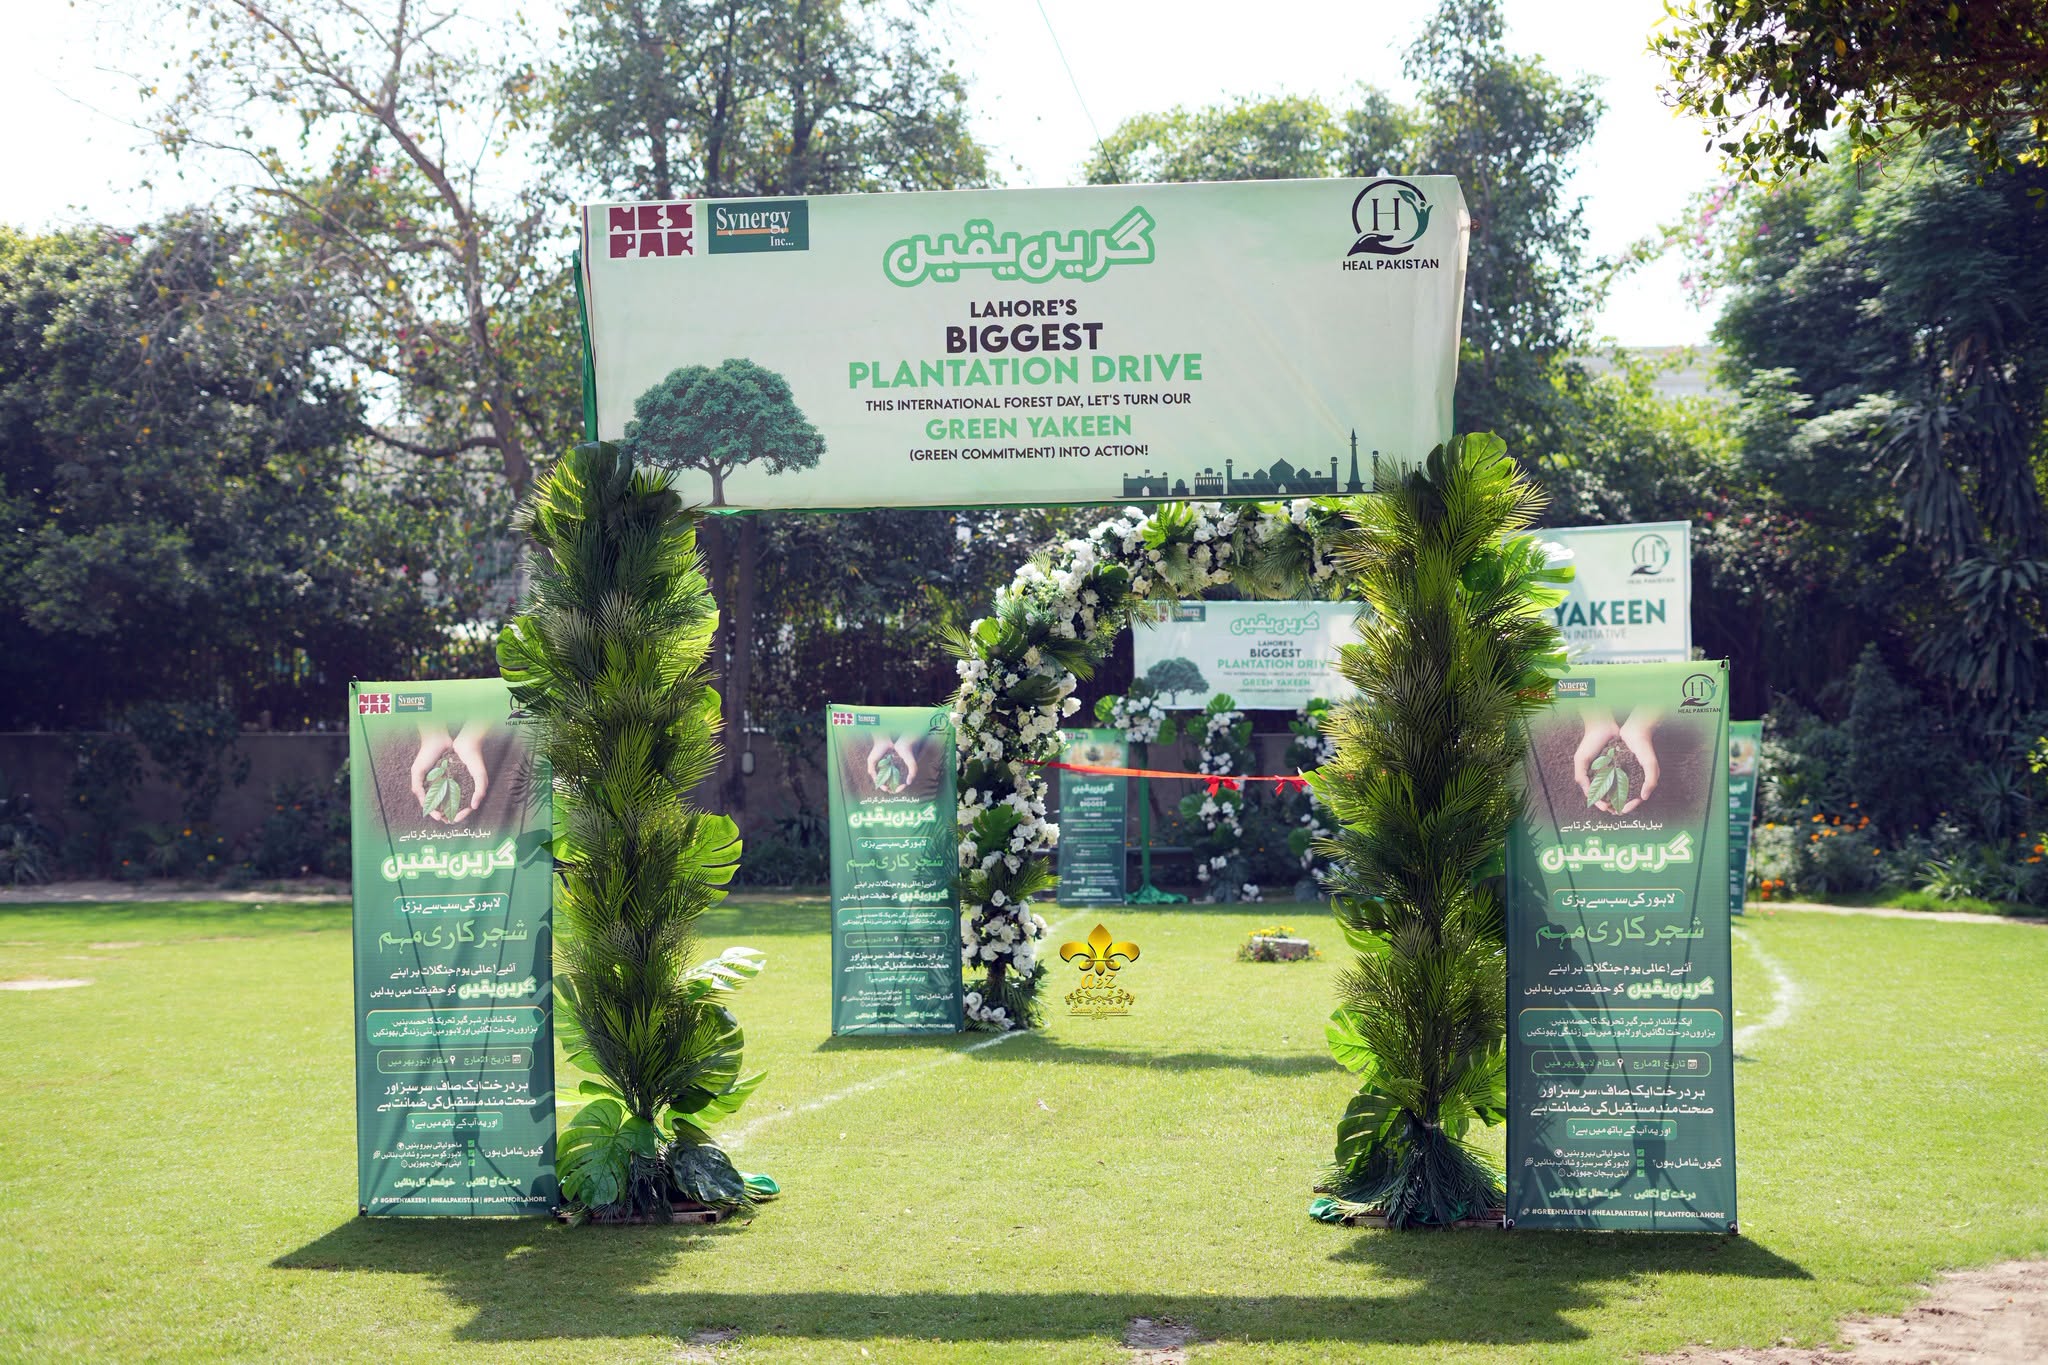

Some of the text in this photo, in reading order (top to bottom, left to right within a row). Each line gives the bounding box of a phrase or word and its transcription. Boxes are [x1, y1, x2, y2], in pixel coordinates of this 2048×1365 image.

[716, 207, 791, 235] Synergy
[770, 236, 794, 246] Inc...
[884, 206, 1155, 287] گرین یقین
[1343, 259, 1439, 270] HEAL PAKISTAN
[970, 299, 1077, 318] LAHORE'S
[946, 322, 1103, 353] BIGGEST
[849, 353, 1202, 388] PLANTATION DRIVE
[865, 392, 1191, 411] THIS INTERNATIONAL FOREST DAY, LET'S TURN OUR
[925, 414, 1132, 440] GREEN YAKEEN
[909, 444, 1148, 461] (GREEN COMMITMENT) INTO ACTION!
[1554, 598, 1666, 627] YAKEEN
[1230, 613, 1275, 635] یقین
[1275, 610, 1319, 634] گرین
[1573, 627, 1627, 639] INITIATIVE
[1249, 648, 1302, 658] BIGGEST
[1217, 658, 1296, 669] PLANTATION
[1242, 678, 1310, 687] GREEN YAKEEN
[1557, 680, 1588, 690] Synergy
[398, 695, 426, 705] Synergy
[849, 803, 936, 828] گرین یقین
[1592, 820, 1613, 831] پیش
[1613, 819, 1645, 831] پاکستان
[445, 828, 474, 839] پاکستان
[1540, 831, 1692, 873] گرین یقین
[382, 837, 517, 881] گرین یقین
[401, 897, 501, 914] لاہور کی سب سے بڑی
[1562, 893, 1675, 909] لاہور کی سب سے بڑی
[378, 919, 528, 954] شجر کاری مہم
[1535, 916, 1704, 950] شجر کاری مہم
[422, 964, 456, 976] جنگلات
[456, 967, 472, 977] یوم
[1548, 963, 1570, 976] اپنے
[1571, 966, 1583, 975] پر
[1584, 962, 1623, 974] جنگلات
[1623, 965, 1641, 976] یوم
[395, 987, 413, 998] میں
[414, 985, 446, 996] حقیقت
[447, 983, 456, 996] کو
[458, 979, 497, 1000] یقین
[496, 976, 537, 999] گرین
[1524, 976, 1714, 999] گرین یقین کو حقیقت میں بدلیں
[482, 1079, 516, 1092] درخت
[1631, 1084, 1654, 1097] ایک
[1539, 1086, 1559, 1099] اور
[1654, 1086, 1690, 1100] درخت
[1690, 1088, 1706, 1100] ہر
[391, 1096, 428, 1109] ضمانت
[428, 1096, 443, 1111] کی
[443, 1096, 484, 1109] مستقبل
[508, 1097, 537, 1107] صحت
[1530, 1101, 1714, 1116] صحت مند مستقبل کی ضمانت ہے
[1623, 1125, 1637, 1137] کے
[1532, 1208, 1725, 1219] #GREENYAKEEN #HEALPAKISTAN #PLANTFORLAHORE
